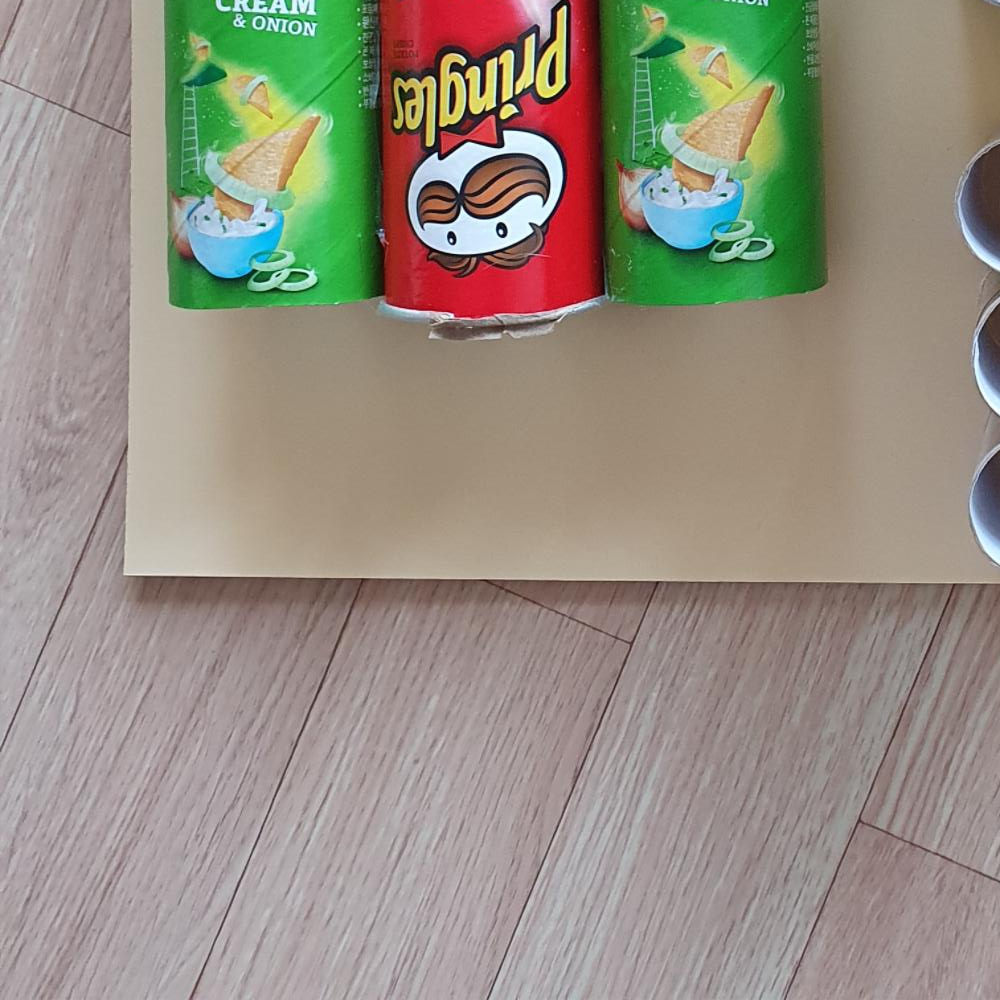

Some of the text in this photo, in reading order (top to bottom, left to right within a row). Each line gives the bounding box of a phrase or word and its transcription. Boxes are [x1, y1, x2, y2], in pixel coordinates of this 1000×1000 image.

[232, 14, 318, 37] & ONION
[392, 4, 568, 148] Pringles
